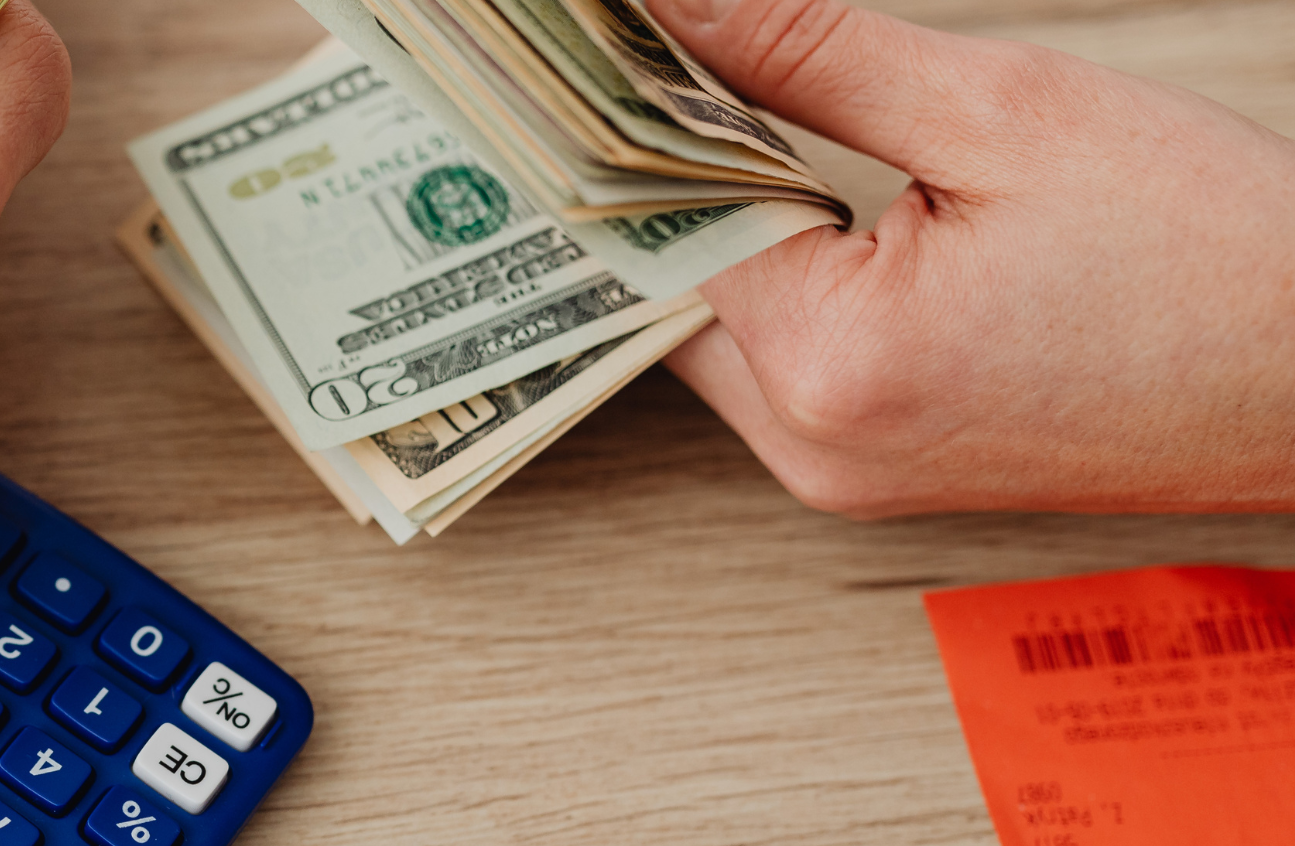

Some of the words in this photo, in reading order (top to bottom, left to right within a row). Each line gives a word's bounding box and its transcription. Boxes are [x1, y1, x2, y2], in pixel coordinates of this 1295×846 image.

[228, 142, 337, 200] 20
[337, 275, 506, 354] STATES
[493, 282, 542, 307] THE
[476, 314, 556, 357] NOTE
[309, 357, 419, 421] 20
[130, 625, 163, 657] 0
[83, 687, 109, 716] 1
[29, 747, 63, 776] 4
[158, 744, 207, 785] CE
